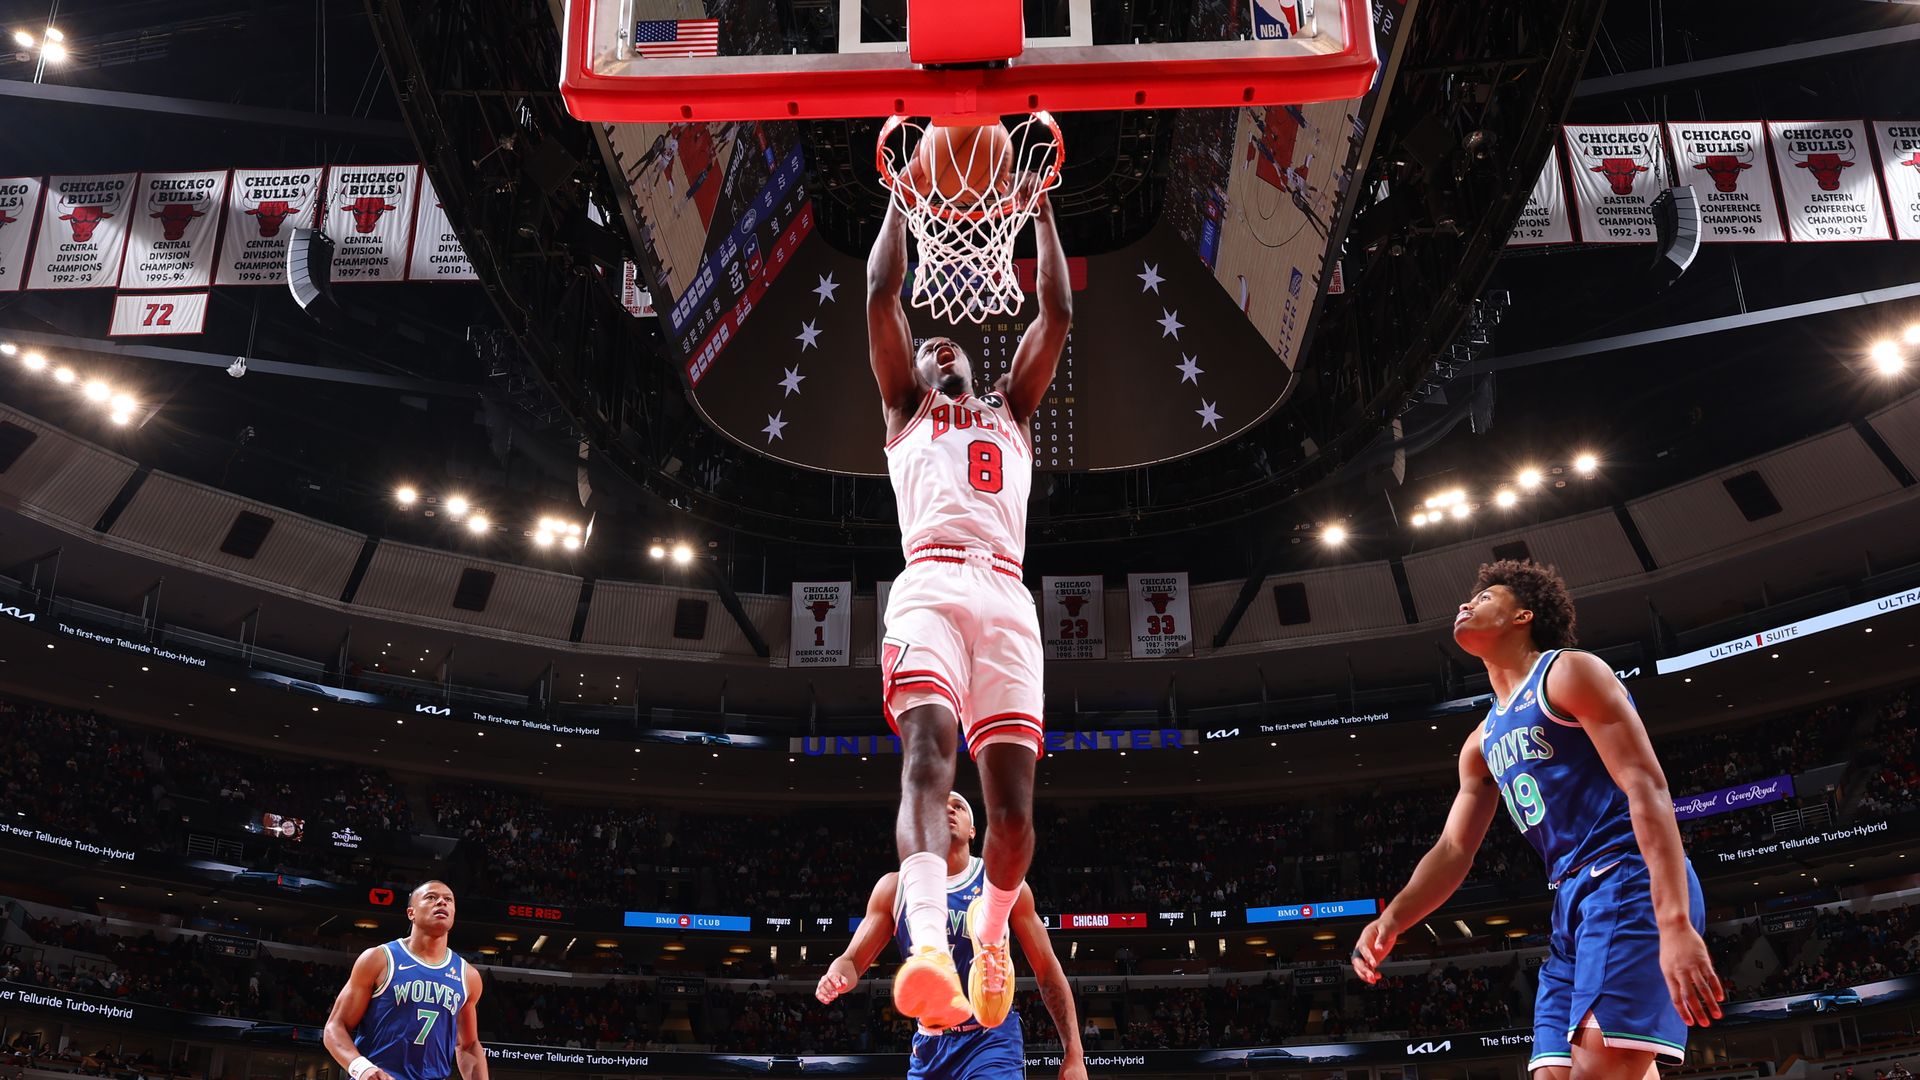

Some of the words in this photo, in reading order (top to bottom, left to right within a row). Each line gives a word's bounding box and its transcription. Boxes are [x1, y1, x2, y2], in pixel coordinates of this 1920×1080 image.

[1372, 0, 1384, 25] BLK
[1382, 9, 1394, 36] TOV
[1260, 24, 1282, 38] NBA
[1579, 132, 1649, 144] CHICAGO
[1682, 130, 1751, 140] CHICAGO
[1783, 128, 1853, 139] CHICAGO
[1593, 144, 1642, 156] BULLS
[1696, 142, 1745, 153] BULLS
[1797, 140, 1847, 152] BULLS
[245, 174, 310, 186] CHICAGO
[340, 172, 405, 184] CHICAGO
[60, 180, 125, 193] CHICAGO
[150, 178, 215, 190] CHICAGO
[349, 184, 396, 195] BULLS
[68, 193, 114, 204] BULLS
[158, 191, 204, 202] BULLS
[252, 188, 299, 199] BULLS
[1708, 193, 1749, 201] EASTERN
[1811, 193, 1853, 202] EASTERN
[1604, 196, 1645, 204] EASTERN
[1700, 204, 1761, 212] CONFERENCE
[1804, 205, 1866, 214] CONFERENCE
[1599, 217, 1656, 226] CHAMPIONS
[1703, 215, 1762, 223] CHAMPIONS
[1808, 215, 1868, 224] CHAMPIONS
[1513, 229, 1544, 238] 91-92
[1713, 226, 1756, 235] 1995-96
[153, 241, 191, 249] CENTRAL
[246, 240, 285, 248] CENTRAL
[344, 236, 382, 244] CENTRAL
[60, 243, 98, 252] CENTRAL
[341, 247, 383, 255] DIVISION
[56, 254, 98, 262] DIVISION
[149, 251, 190, 260] DIVISION
[243, 250, 285, 259] DIVISION
[430, 255, 470, 264] CHAMPI
[139, 261, 194, 271] CHAMPIONS
[234, 261, 288, 270] CHAMPIONS
[333, 257, 389, 266] CHAMPIONS
[47, 263, 102, 272] CHAMPIONS
[143, 303, 174, 326] 72
[1035, 422, 1040, 430] 0
[1068, 421, 1073, 429] 1
[968, 440, 1003, 494] 8
[1060, 619, 1089, 639] 23
[1147, 614, 1176, 635] 33
[814, 626, 824, 646] 1
[58, 622, 75, 635] The
[76, 628, 114, 645] first-ever
[116, 638, 150, 654] Telluride
[152, 647, 206, 667] Turbo-Hybrid
[1709, 639, 1753, 658] ULTRA
[1766, 626, 1798, 643] SUITE
[416, 704, 450, 716] KIA
[472, 712, 486, 721] The
[488, 715, 520, 726] first-ever
[521, 720, 550, 731] Telluride
[552, 724, 600, 736] Turbo-Hybrid
[1206, 728, 1239, 739] KIA
[1260, 724, 1274, 733] The
[1275, 720, 1307, 732] first-ever
[1309, 716, 1339, 728] Telluride
[1340, 712, 1389, 725] Turbo-Hybrid
[802, 735, 967, 756] UNIT
[1045, 729, 1184, 751] ENTER
[1502, 773, 1546, 834] 19
[0, 823, 33, 838] st-ever
[35, 830, 72, 848] Telluride
[75, 840, 135, 860] Turbo-Hybrid
[1718, 853, 1735, 862] The
[1737, 844, 1777, 858] first-ever
[1780, 835, 1820, 850] Telluride
[1822, 821, 1888, 843] Turbo-Hybrid
[508, 905, 533, 917] SEE
[535, 908, 562, 920] RED
[1210, 910, 1226, 918] FOULS
[1278, 908, 1298, 917] BMO
[1321, 905, 1344, 914] CLUB
[655, 916, 676, 925] BMO
[698, 918, 720, 927] CLUB
[1044, 917, 1049, 927] 3
[1073, 915, 1108, 926] CHICAGO
[394, 980, 461, 1016] WOLVES
[19, 991, 62, 1008] Telluride
[66, 998, 133, 1019] Turbo-Hybrid
[414, 1009, 440, 1045] 7
[1407, 1040, 1451, 1055] KIA
[1480, 1037, 1499, 1047] The
[1501, 1035, 1535, 1045] first-ev
[483, 1048, 500, 1058] The
[502, 1049, 544, 1061] first-ever
[546, 1052, 584, 1064] Telluride
[586, 1055, 648, 1067] Turbo-Hybrid
[1084, 1056, 1145, 1067] Turbo-Hybrid
